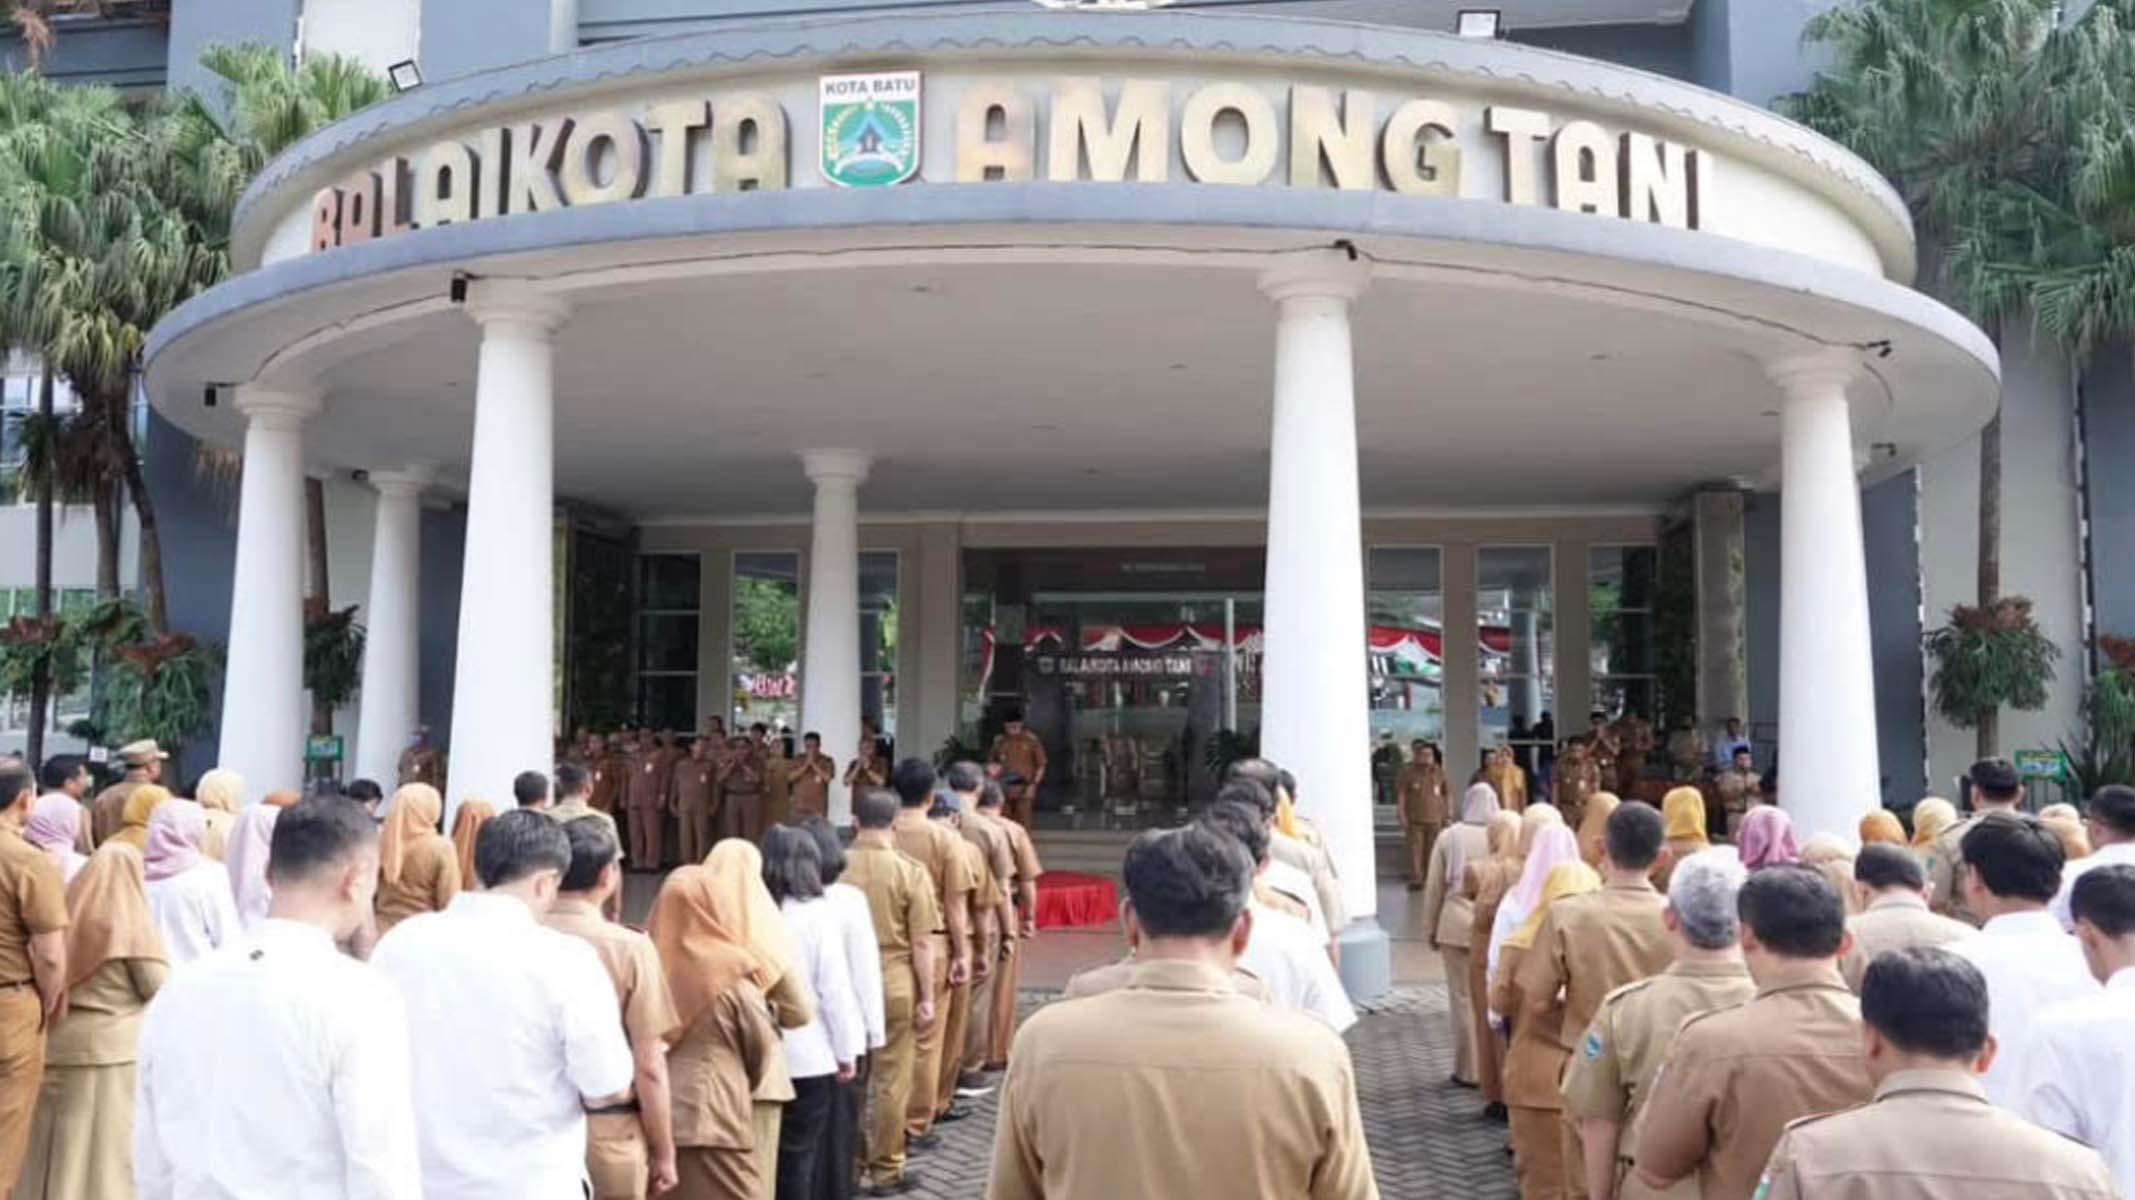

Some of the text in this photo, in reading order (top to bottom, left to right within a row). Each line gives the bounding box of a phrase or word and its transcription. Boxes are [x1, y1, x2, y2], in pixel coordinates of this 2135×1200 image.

[825, 78, 915, 94] KOTA BATU
[310, 78, 1714, 250] BALAIKOTA AMONG TANI
